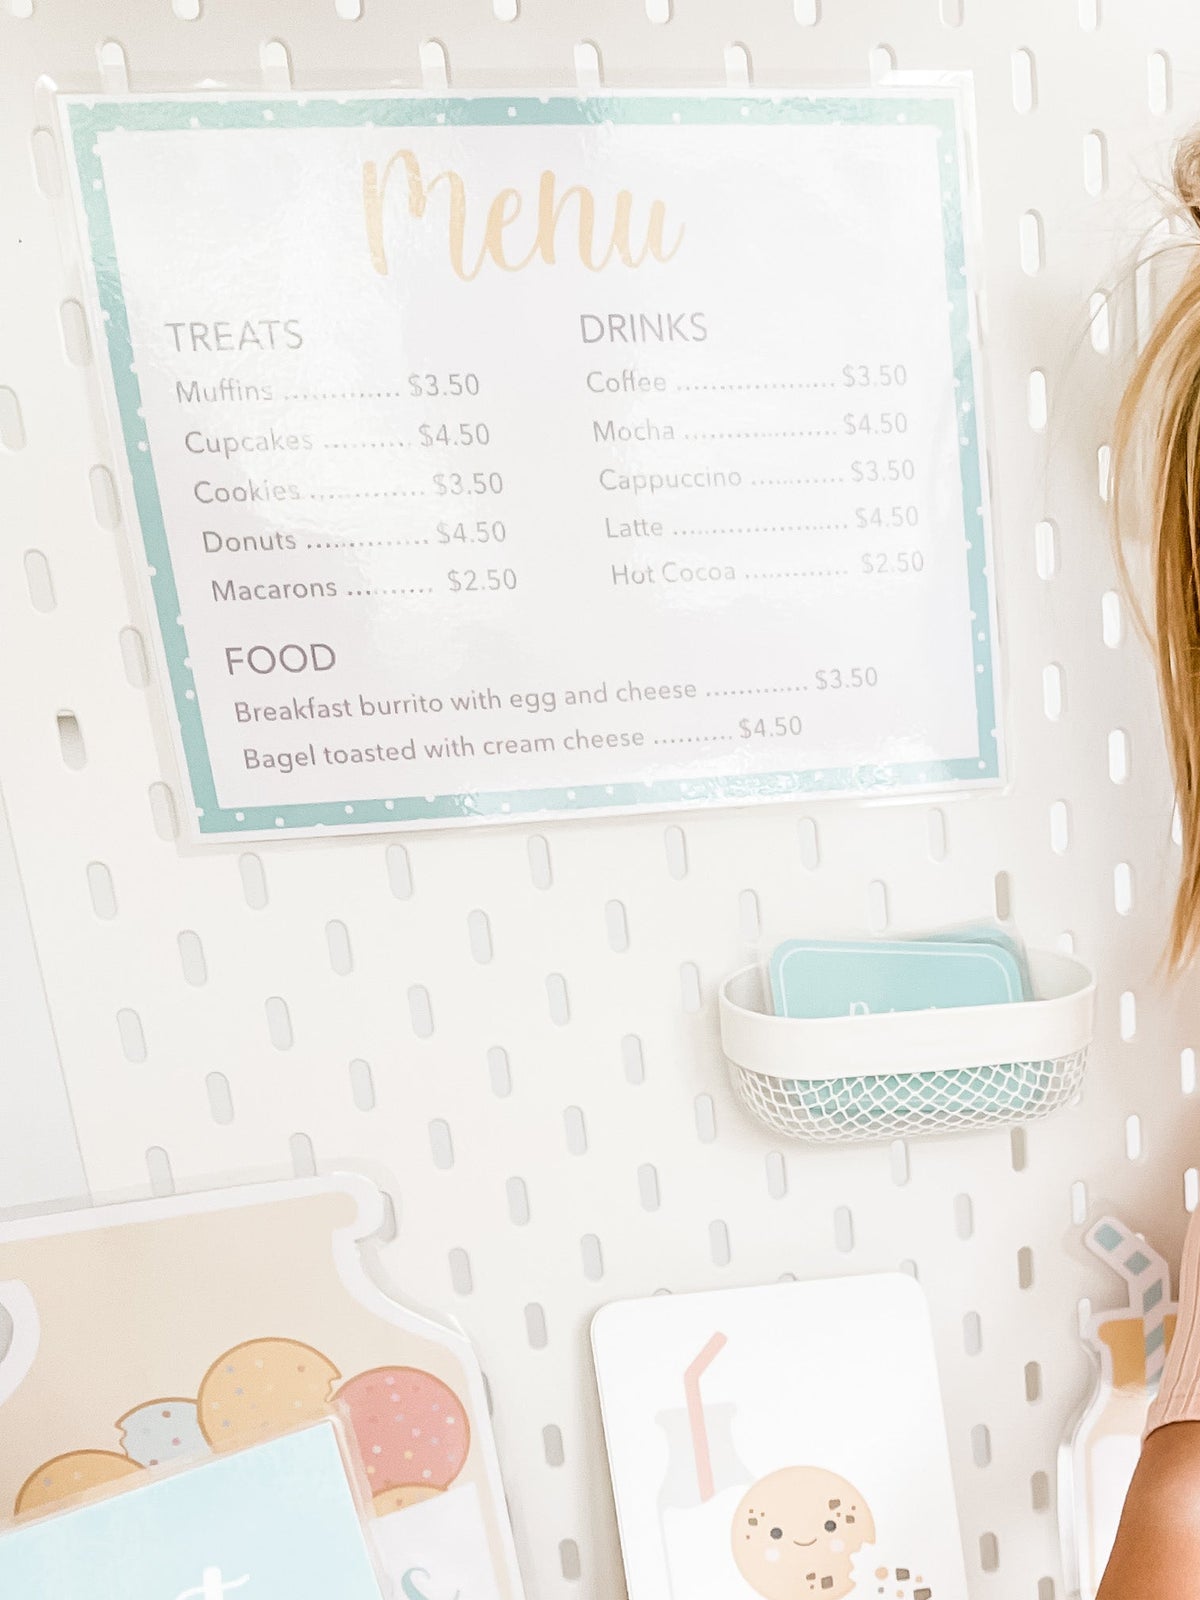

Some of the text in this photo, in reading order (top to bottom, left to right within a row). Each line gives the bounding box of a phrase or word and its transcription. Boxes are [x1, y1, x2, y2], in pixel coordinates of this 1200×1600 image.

[362, 148, 686, 283] Menu
[165, 319, 304, 352] TREATS
[580, 312, 708, 344] DRINKS
[175, 372, 480, 404] Muffins $3.50
[586, 363, 908, 394] Coffee $3.50
[184, 422, 490, 460] Cupcakes $4.50
[592, 411, 908, 443] Mocha $4.50
[193, 472, 504, 504] Cookies $3.50
[599, 458, 915, 496] Cappuccino $3.50
[202, 520, 507, 554] Donuts $4.50
[604, 505, 919, 539] Latte $4.50
[211, 567, 518, 602] Macarons $2.50
[611, 550, 925, 586] Hot Cocoa $2.50
[224, 643, 337, 676] FOOD
[233, 666, 878, 723] Breakfast burrito with egg and cheese $3.50
[242, 714, 802, 774] Bagel toasted with cream cheese $4.50
